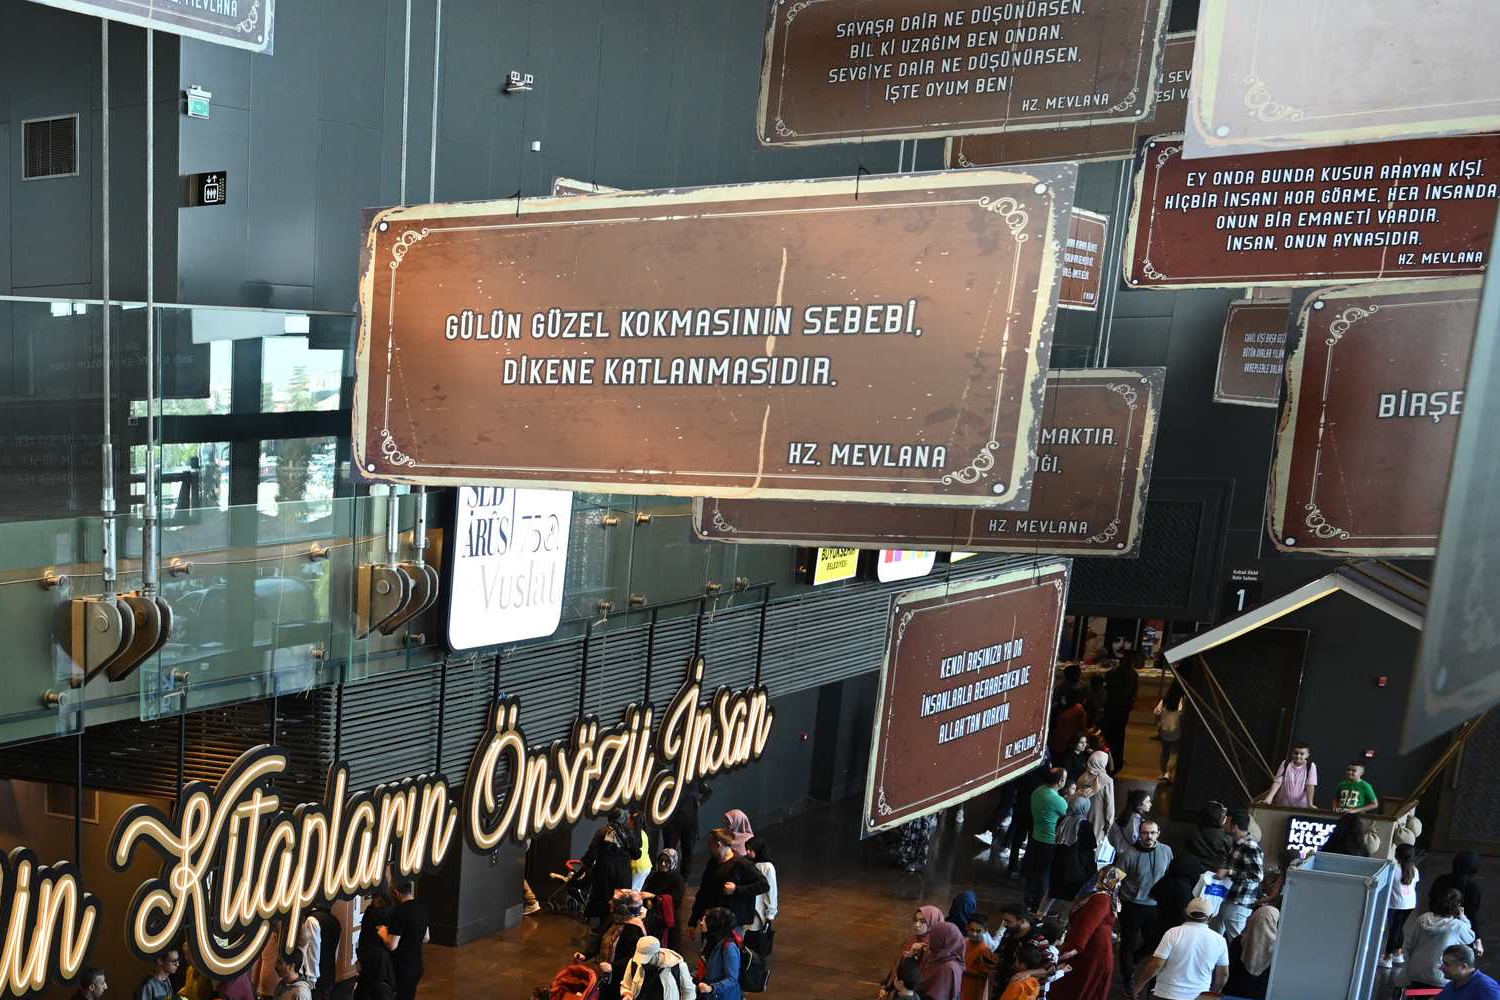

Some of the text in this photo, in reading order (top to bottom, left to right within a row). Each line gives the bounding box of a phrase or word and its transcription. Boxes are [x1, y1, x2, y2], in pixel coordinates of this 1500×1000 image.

[836, 0, 1086, 38] SAVAŞA DAİR NE DÜŞÜNÜRSEN,
[850, 24, 1064, 59] BİL Kİ UZAĞIM BEN ONDAN.
[828, 46, 1082, 84] SEVGİYE DAİR NE DÜŞÜNÜRSEN,
[885, 75, 1015, 104] İŞTE OYUM BEN!
[1021, 93, 1110, 112] HZ. MEVLANA
[1186, 159, 1485, 187] EY ONDA BUNDA KUSUR ARAYAN KİŞİ.
[1164, 191, 1217, 213] HİÇBİR
[1223, 189, 1278, 208] İNSANI
[1284, 189, 1315, 205] HOR
[1321, 187, 1380, 205] GÖRME,
[1387, 185, 1419, 202] HER
[1216, 207, 1440, 229] ONUN BİR EMANETİ VARDIR.
[1226, 231, 1422, 252] İNSAN, ONUN AYNASIDIR.
[1398, 251, 1483, 265] HZ. MEVLANA
[445, 300, 922, 341] GÜLÜN GÜZEL KOKMASININ SEBEBİ,
[502, 355, 839, 387] DİKENE KATLANMASIDIR.
[788, 442, 947, 469] HZ. MEVLANA
[988, 518, 1088, 534] HZ. MEVLANA
[481, 559, 557, 612] Vuslat
[1236, 588, 1246, 612] 1
[940, 637, 1023, 678] KENDİ BAŞINIZA YA DA
[920, 665, 1031, 718] İNSANLARLA BERABERKEN DE
[938, 702, 1010, 745] ALLAH'TAN KORKUN.
[1013, 732, 1037, 757] MEVLANA
[114, 749, 457, 973] Kitapların
[471, 702, 654, 850] Önsözü
[1288, 829, 1331, 847] kita
